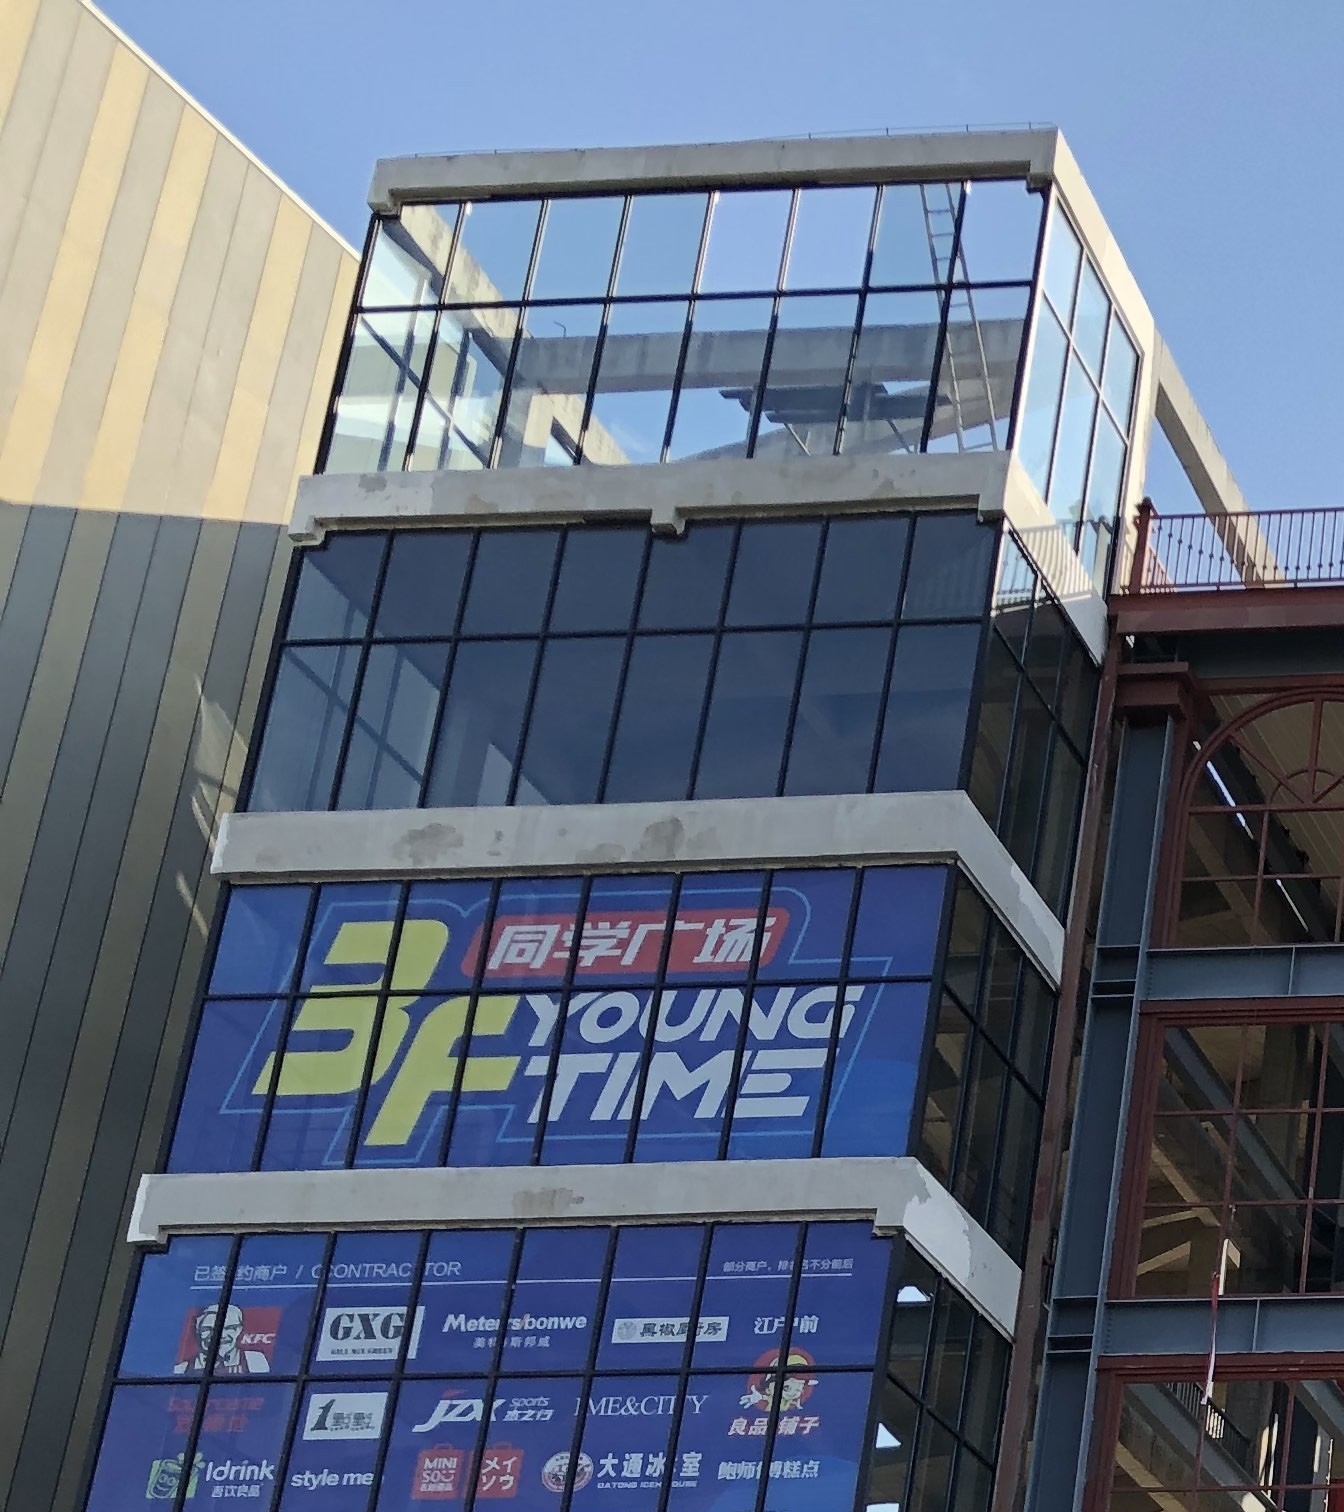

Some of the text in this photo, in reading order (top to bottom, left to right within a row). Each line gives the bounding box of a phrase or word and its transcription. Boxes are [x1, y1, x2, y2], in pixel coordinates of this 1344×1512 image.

[487, 915, 776, 969] 同学广场
[524, 985, 864, 1045] YOUNG
[524, 1047, 840, 1124] TIME
[241, 1333, 276, 1344] KFC
[330, 1313, 405, 1340] GXG
[728, 1416, 820, 1435] 良品铺子
[424, 1457, 457, 1469] MINI
[597, 1452, 703, 1478] 大通冰室
[291, 1469, 374, 1490] style me
